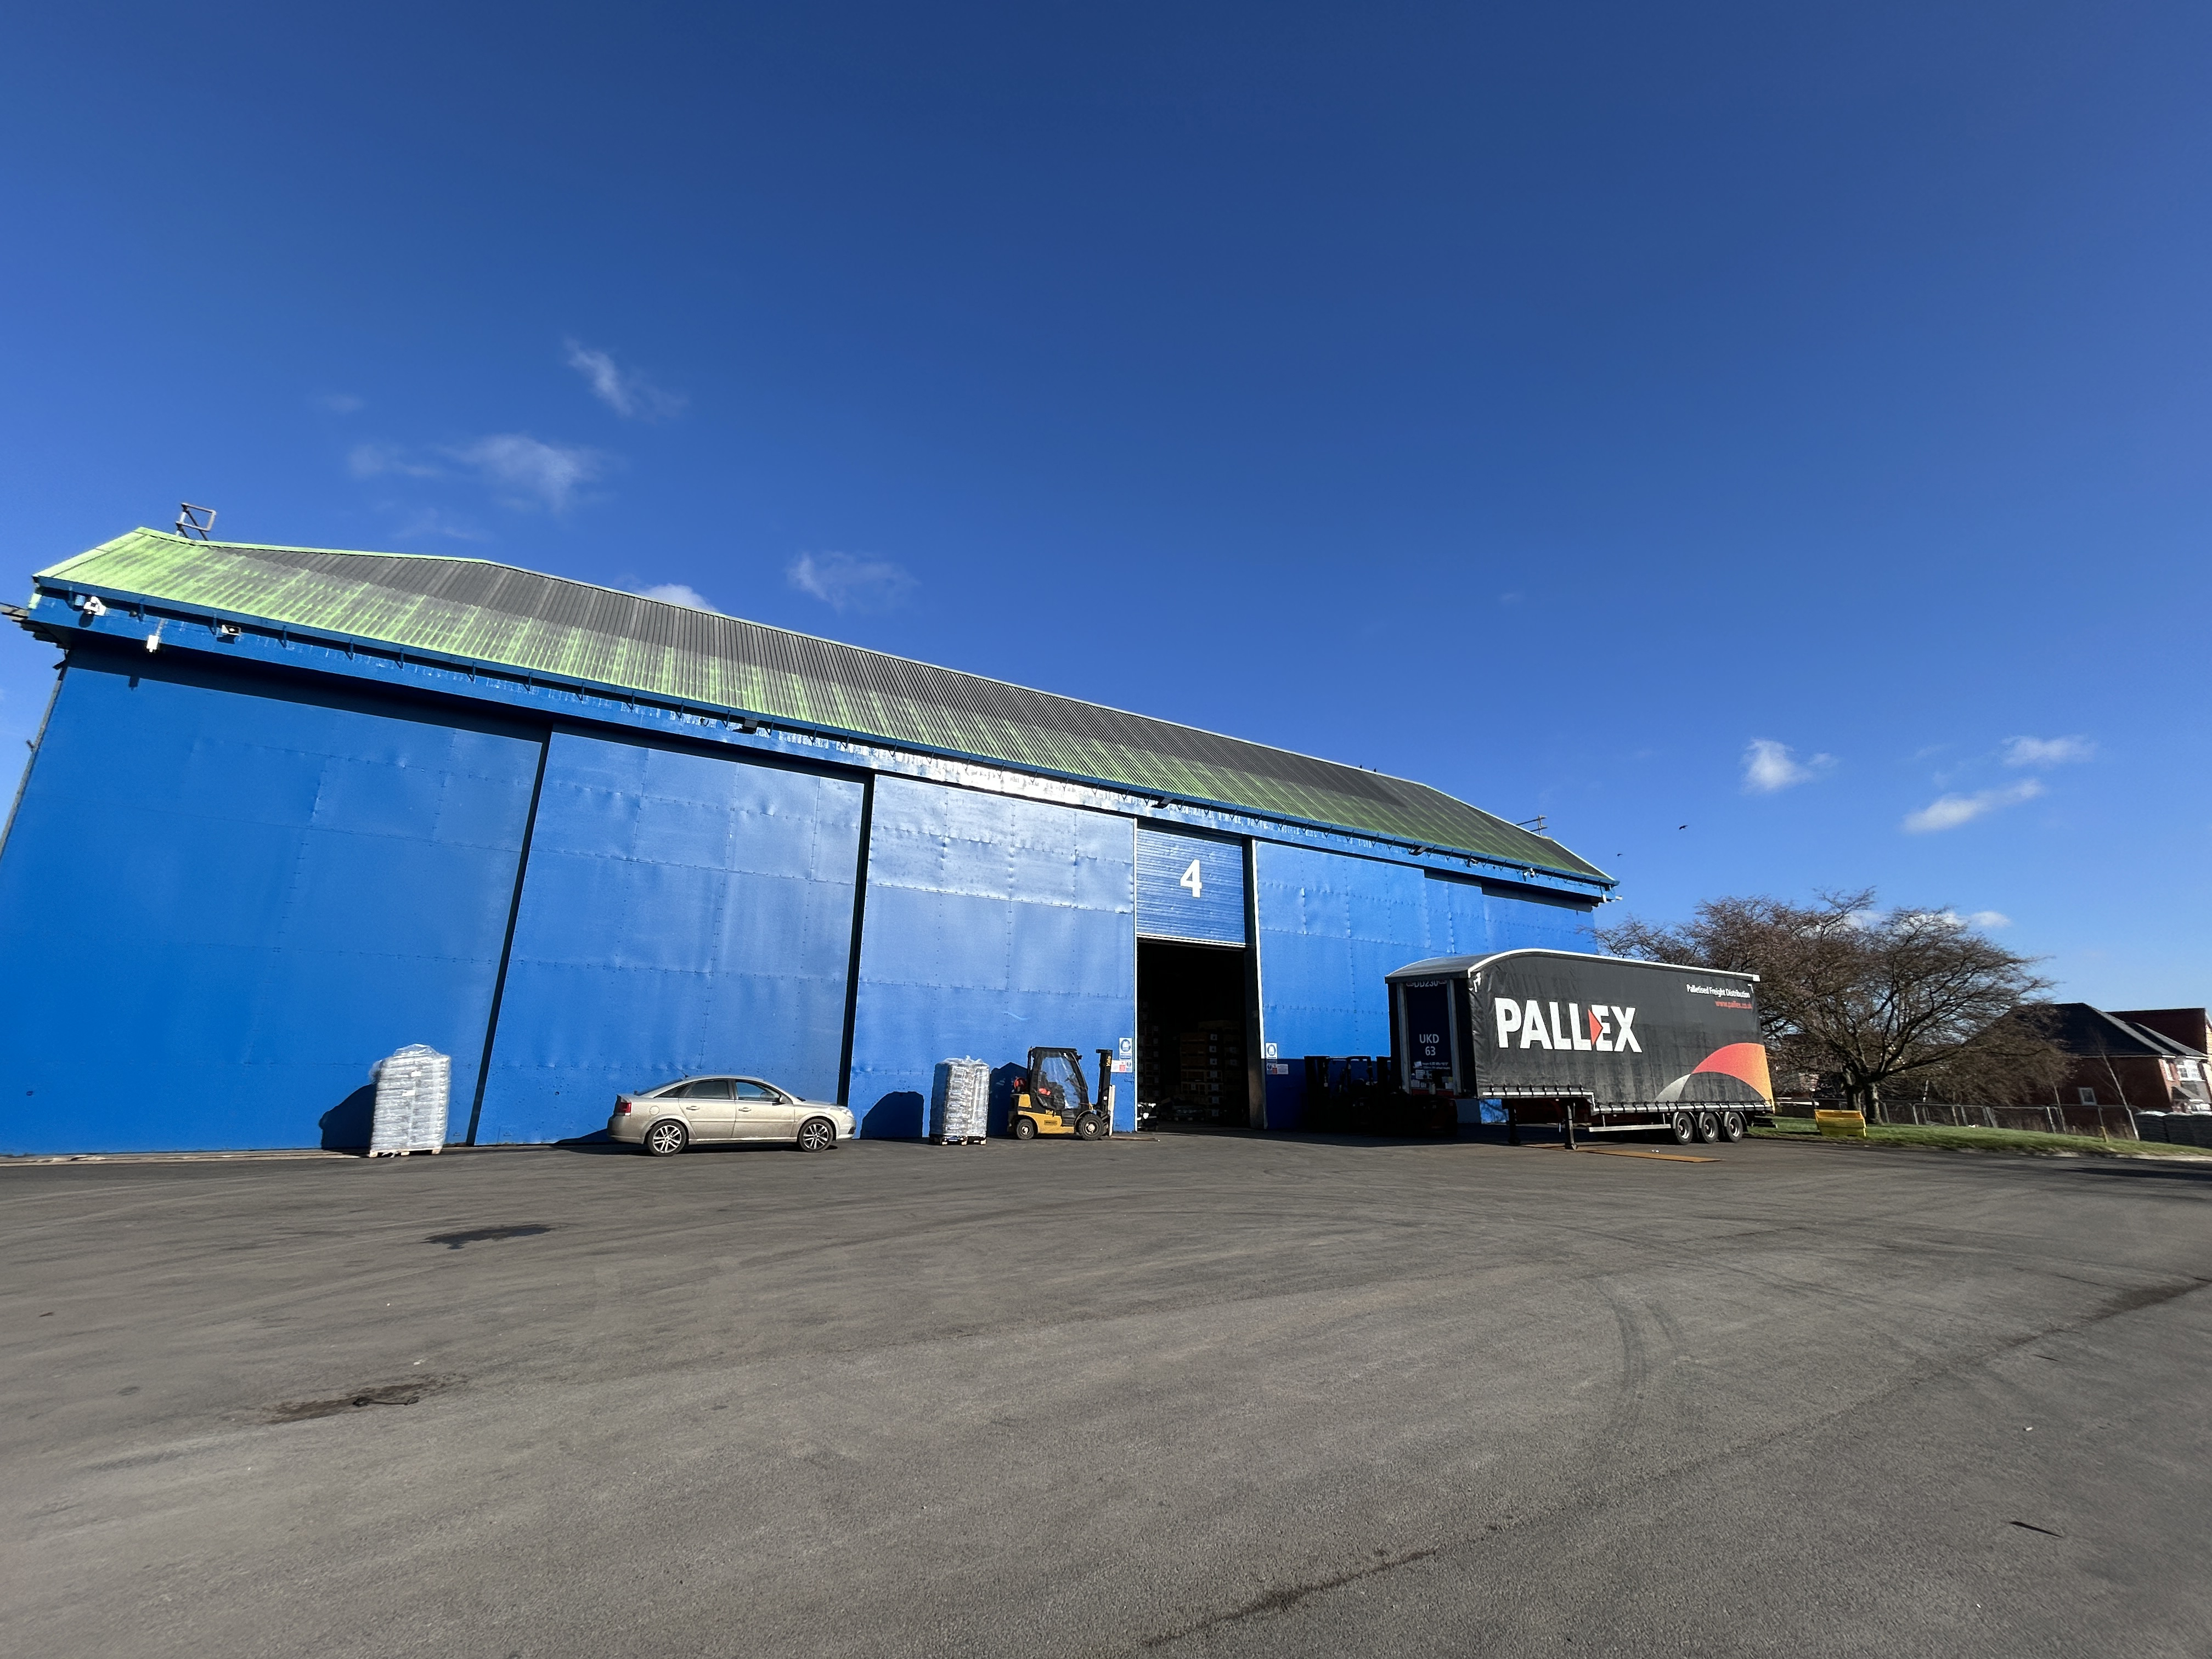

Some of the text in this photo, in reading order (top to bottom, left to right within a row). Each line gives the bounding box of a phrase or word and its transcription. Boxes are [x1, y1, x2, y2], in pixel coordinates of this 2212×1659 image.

[1180, 859, 1202, 898] 4
[1686, 984, 1750, 998] Palletised Freight Distribution
[1494, 997, 1643, 1053] PALLEX
[1419, 1034, 1440, 1043] UKD
[1425, 1046, 1436, 1056] 63
